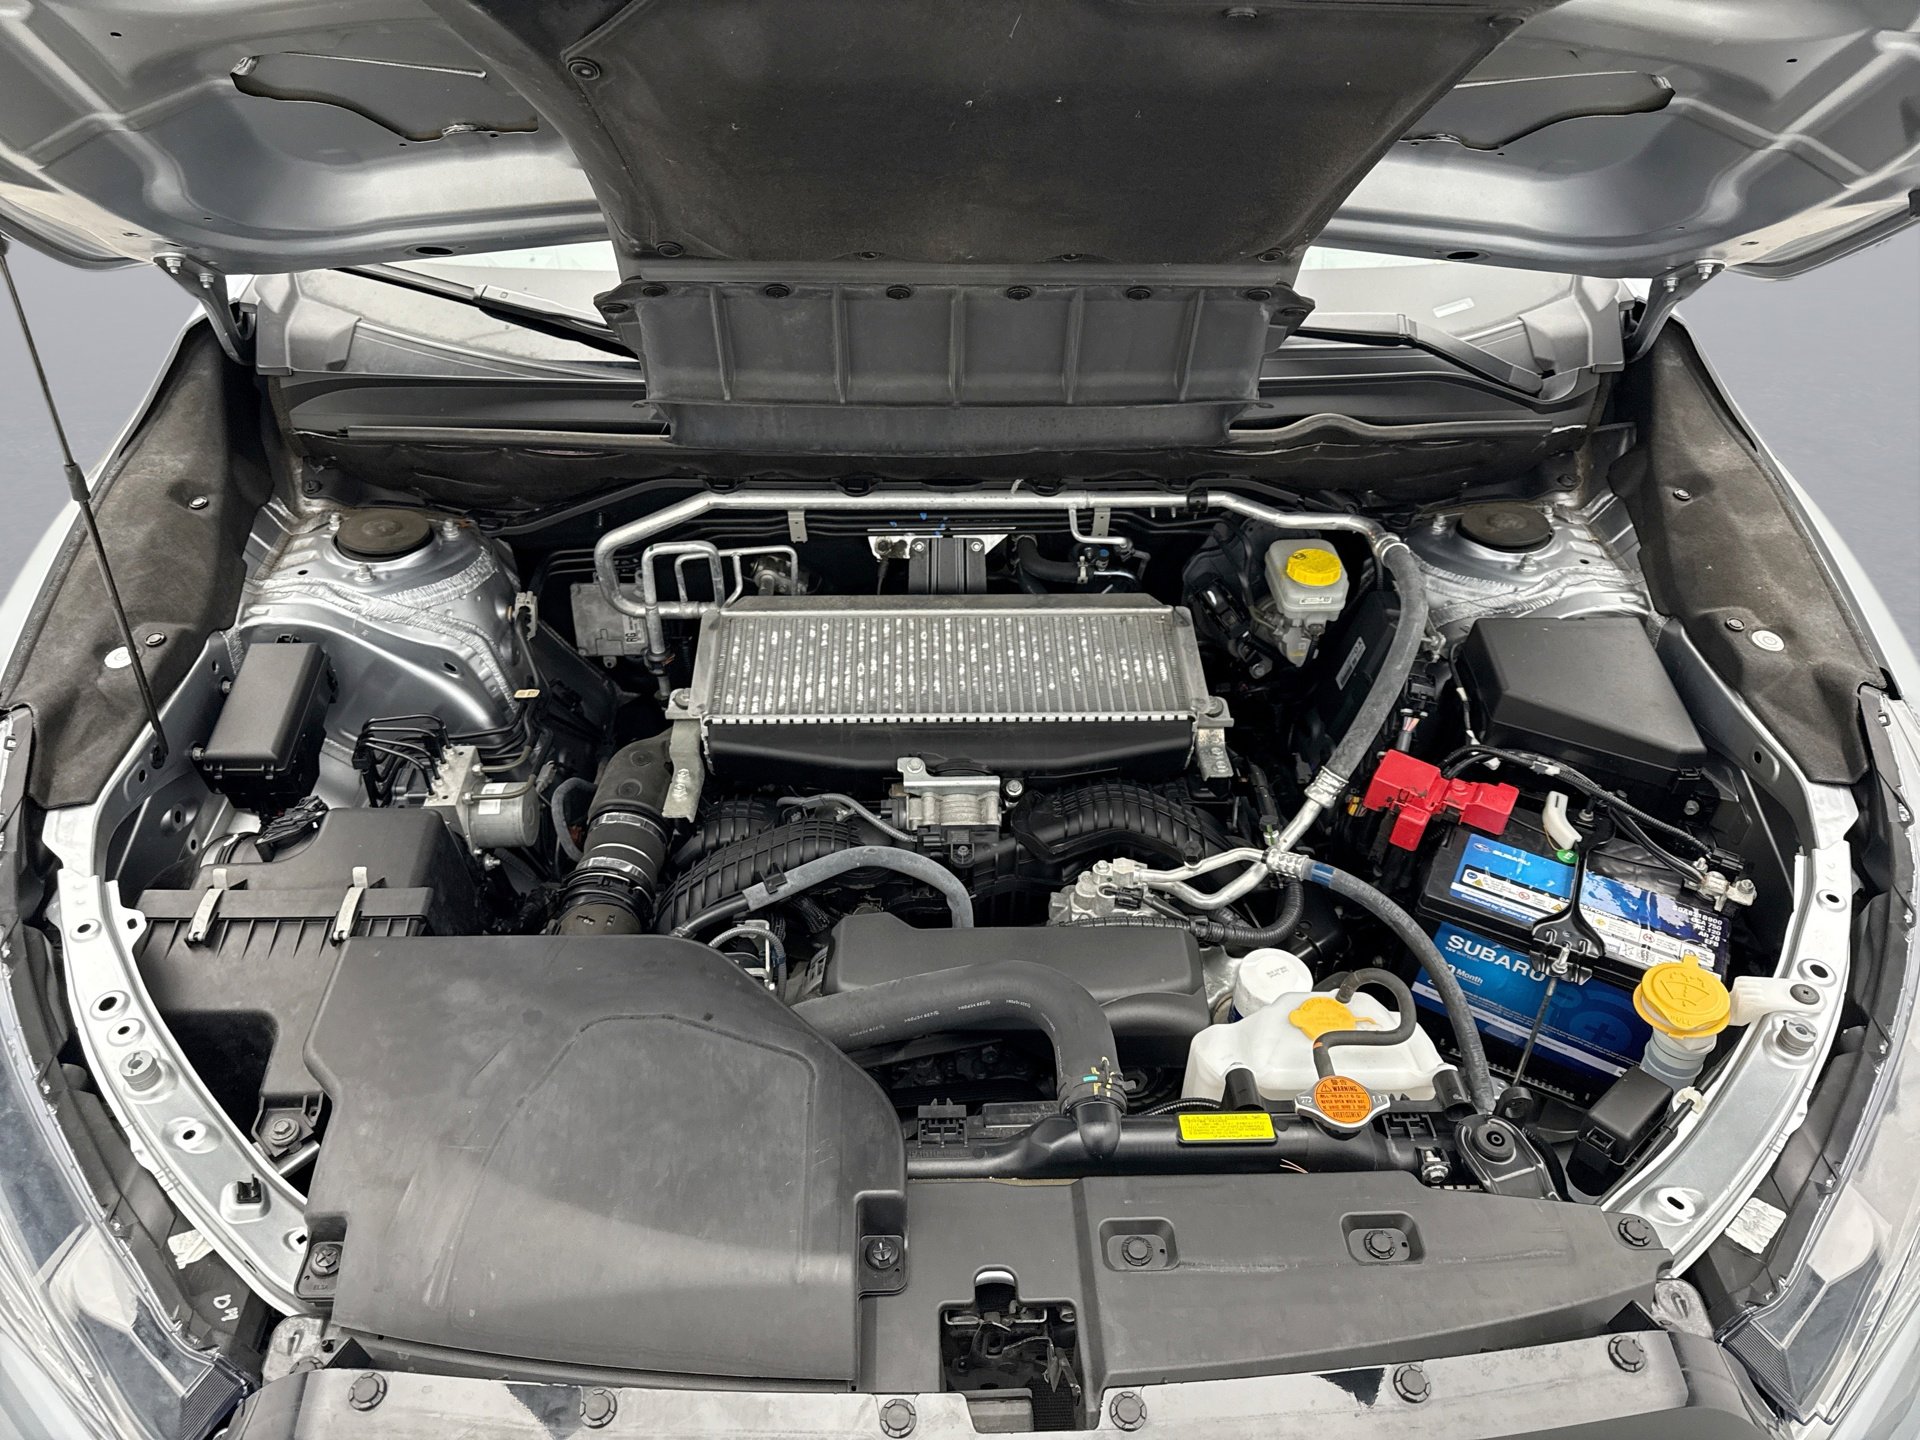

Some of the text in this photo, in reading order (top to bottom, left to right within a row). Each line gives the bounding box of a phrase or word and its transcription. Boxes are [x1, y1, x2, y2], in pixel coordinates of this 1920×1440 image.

[1492, 850, 1531, 866] SUBARU
[1447, 935, 1546, 982] SUBARU
[1456, 967, 1484, 984] Month
